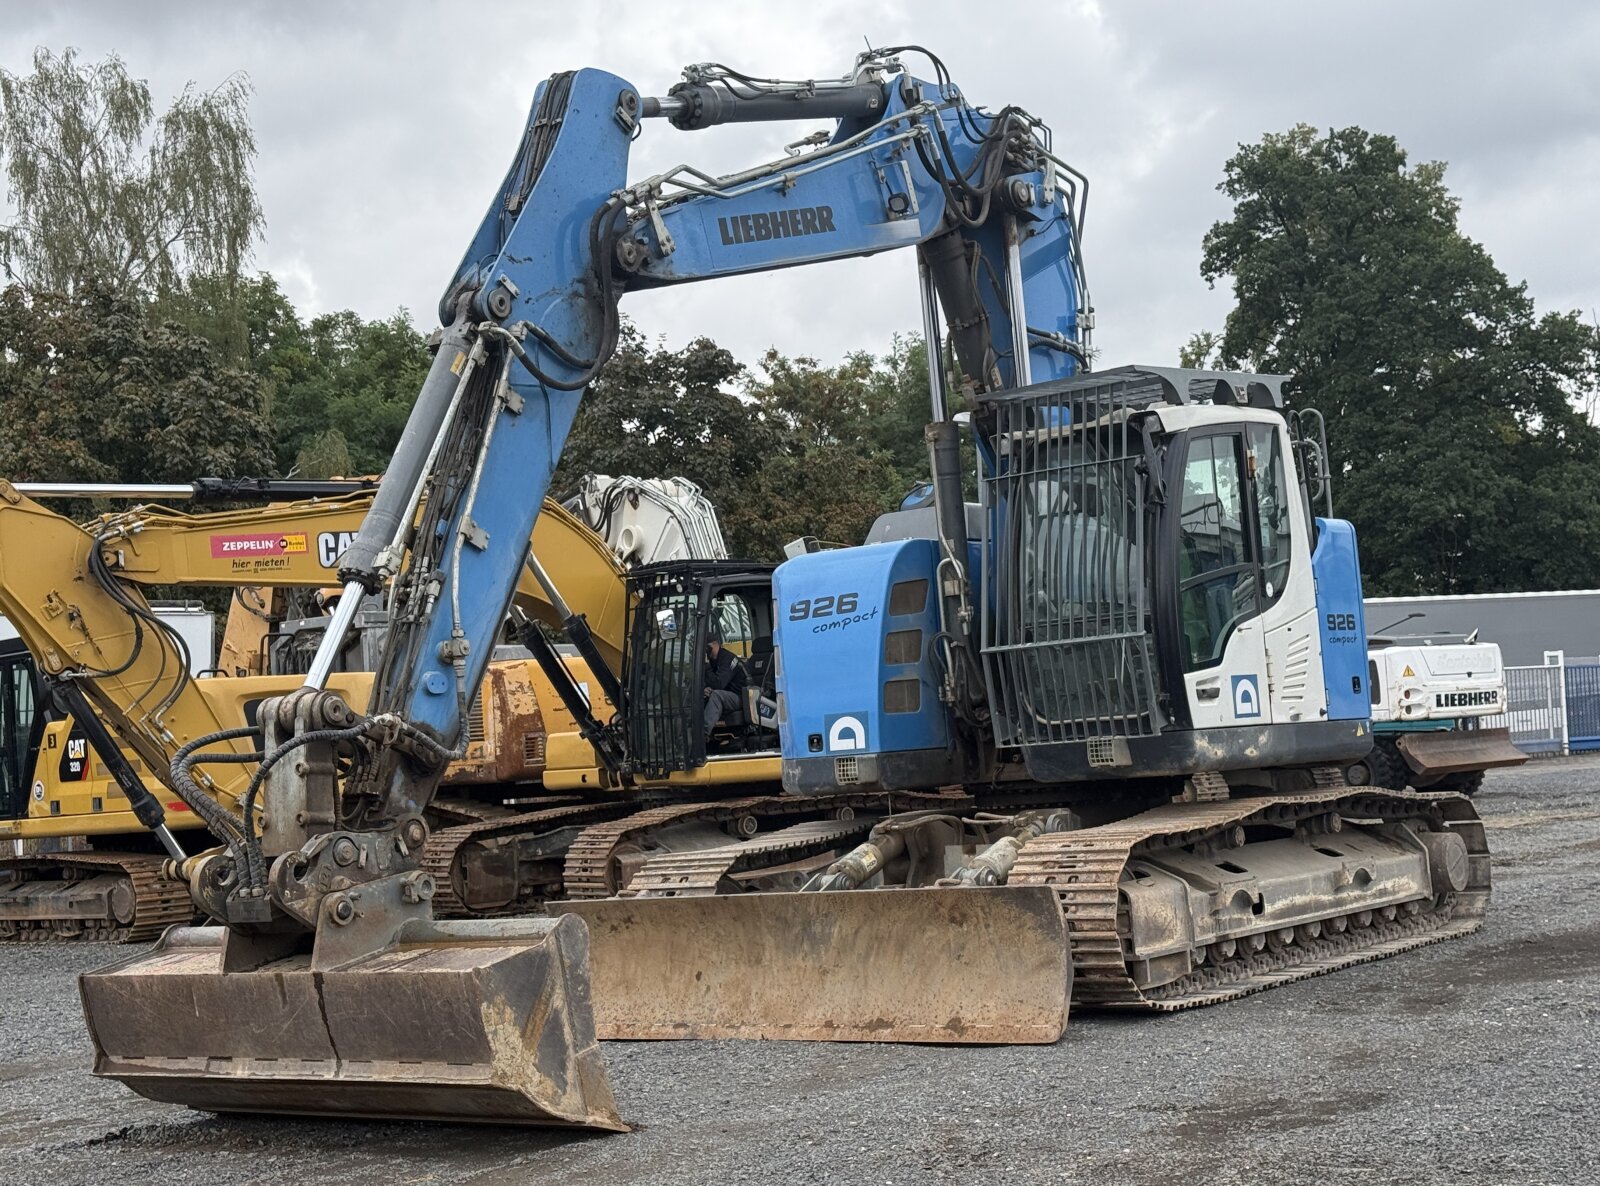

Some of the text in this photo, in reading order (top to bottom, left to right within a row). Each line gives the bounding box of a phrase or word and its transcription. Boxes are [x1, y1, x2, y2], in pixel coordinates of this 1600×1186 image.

[718, 206, 836, 245] LIEBHERR
[222, 540, 274, 551] ZEPPELIN
[318, 532, 359, 568] CA
[232, 559, 251, 568] hier
[789, 593, 858, 621] 926
[812, 605, 878, 633] compact
[1327, 614, 1356, 630] 926
[1329, 633, 1357, 646] compact
[1435, 690, 1498, 708] LIEBHERR
[49, 735, 55, 748] 3
[68, 739, 86, 759] CAT
[69, 761, 80, 772] 320
